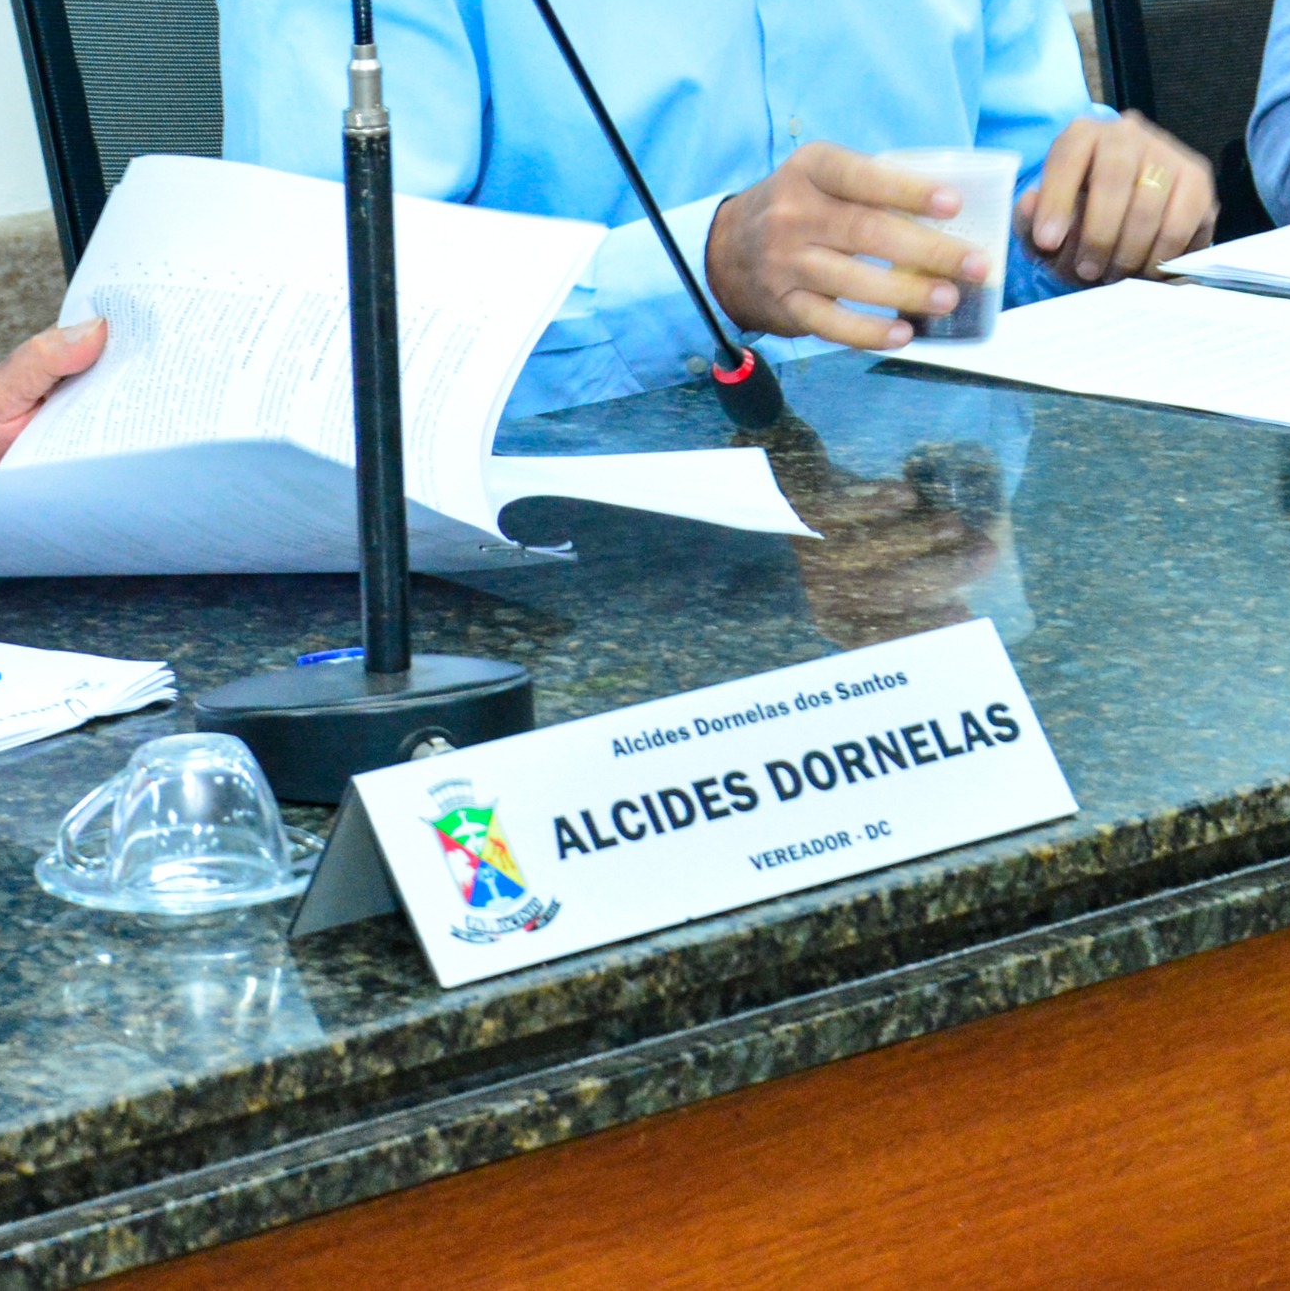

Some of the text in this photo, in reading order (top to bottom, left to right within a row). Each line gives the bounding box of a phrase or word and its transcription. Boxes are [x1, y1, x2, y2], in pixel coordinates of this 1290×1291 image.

[611, 670, 909, 758] Alcides Dornelas dos Santos
[553, 703, 1020, 860] ALCIDES DORNELAS
[748, 830, 853, 873] VEREADOR
[864, 819, 893, 841] DC
